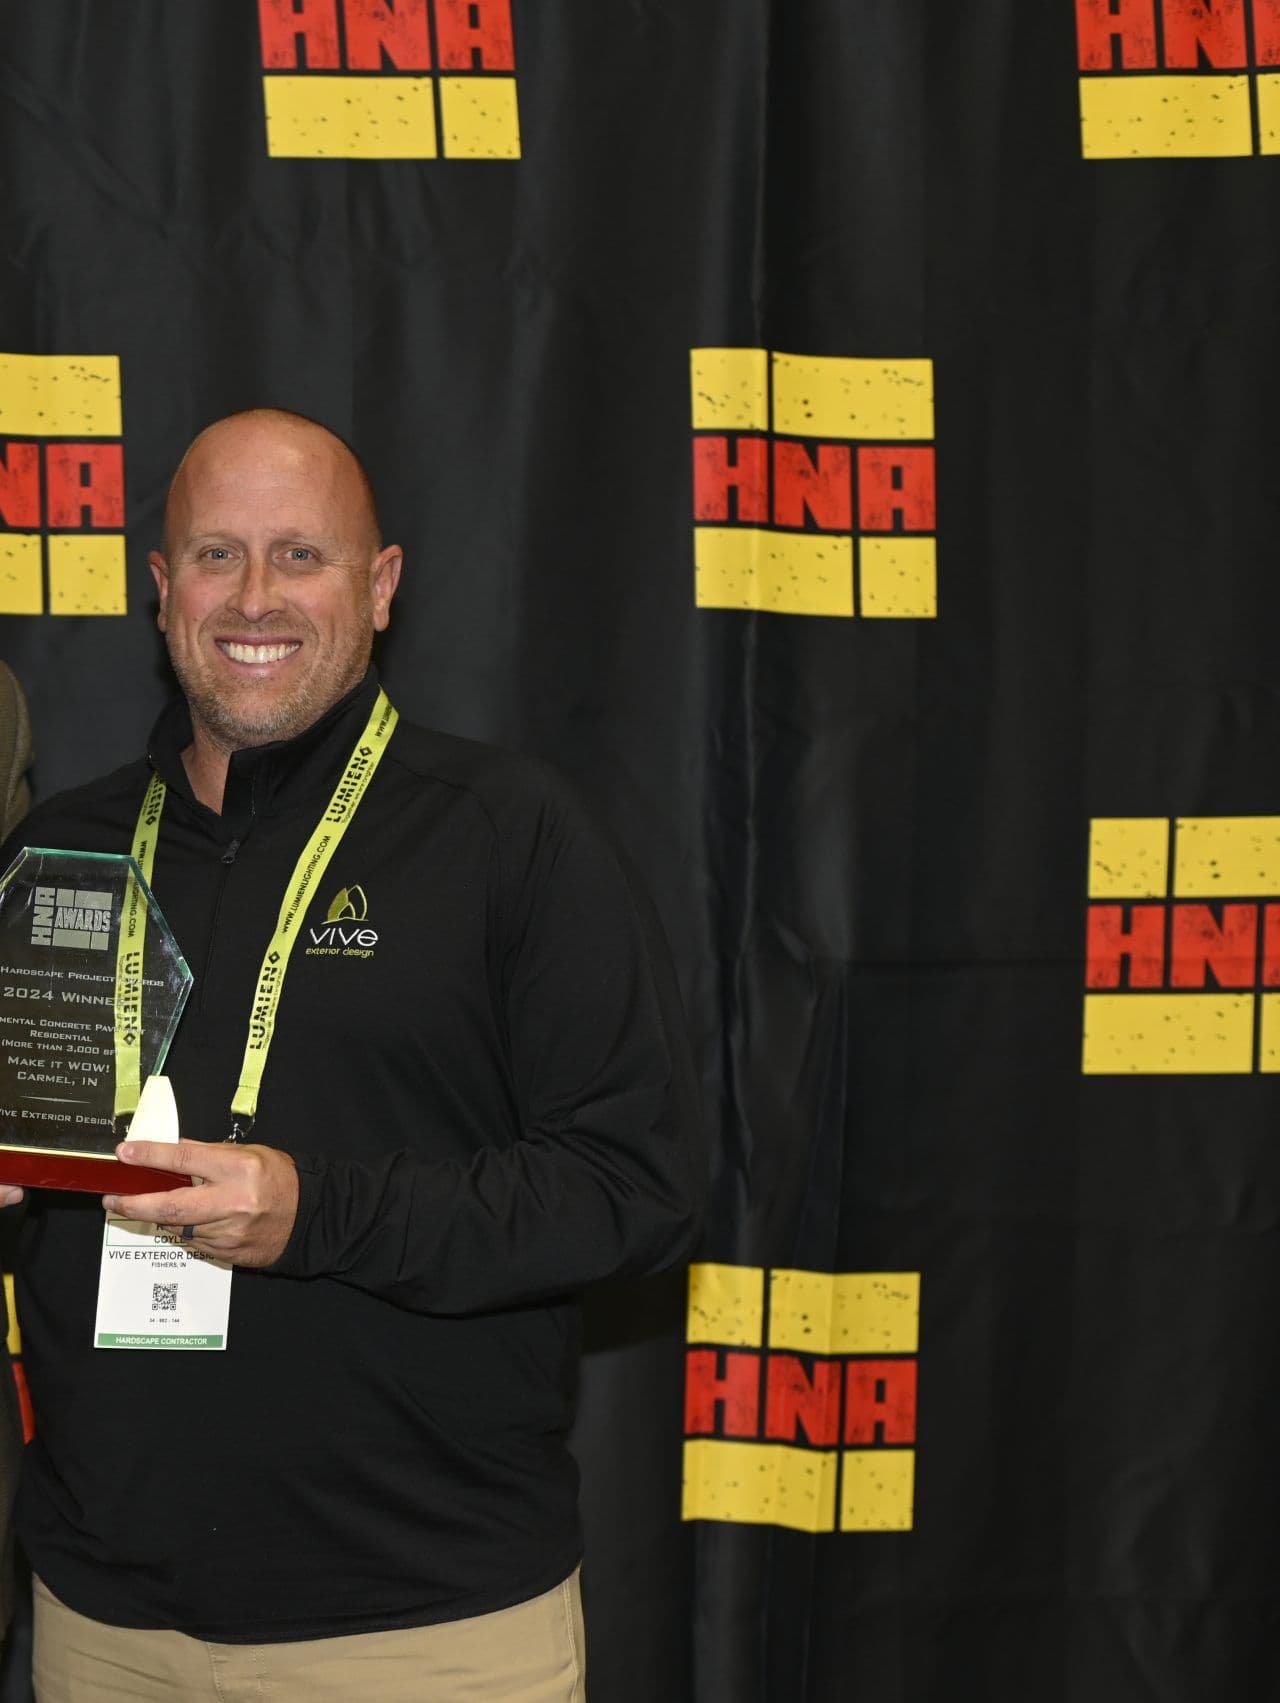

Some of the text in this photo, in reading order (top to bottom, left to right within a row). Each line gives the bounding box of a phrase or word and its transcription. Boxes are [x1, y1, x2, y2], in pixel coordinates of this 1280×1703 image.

[259, 0, 516, 71] HNA
[692, 437, 936, 531] HNA
[326, 757, 368, 822] LUMIEN
[30, 886, 56, 946] HNA
[54, 906, 112, 932] AWARDS
[342, 947, 374, 958] design
[1085, 903, 1280, 989] HN
[0, 966, 64, 978] HARDSCAPE
[68, 972, 116, 982] PROJECT
[3, 986, 54, 1000] 2024
[250, 966, 278, 1049] LUMIEN
[40, 1020, 92, 1030] CONCRETE
[30, 1030, 93, 1042] RESIDENTIAL
[1, 1038, 33, 1048] (MORE
[37, 1043, 63, 1051] THAN
[8, 1056, 110, 1073] MAKE IT WOW!
[17, 1072, 98, 1086] CARMEL, IN
[22, 1110, 72, 1122] EXTERIOR
[108, 1250, 132, 1260] VIVE
[134, 1251, 184, 1260] EXTERIOR
[116, 1336, 160, 1344] HARDSCAPE
[684, 1349, 918, 1446] HNA
